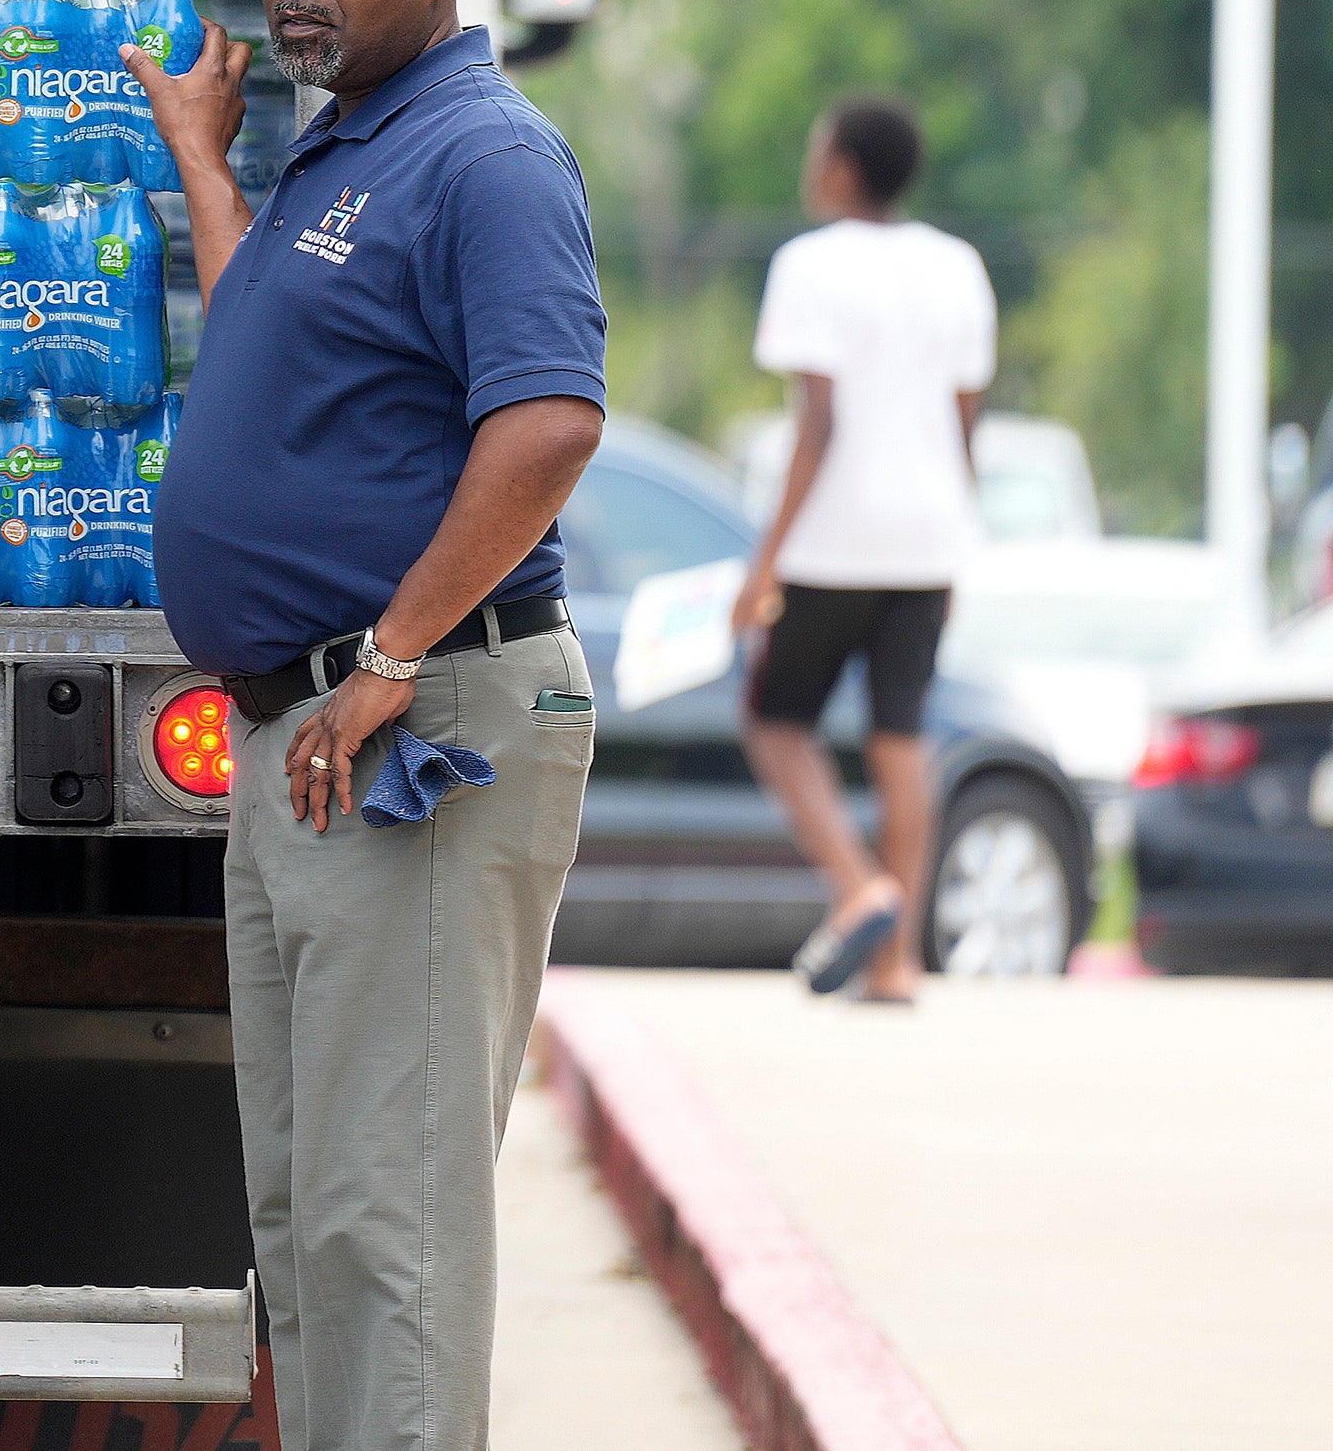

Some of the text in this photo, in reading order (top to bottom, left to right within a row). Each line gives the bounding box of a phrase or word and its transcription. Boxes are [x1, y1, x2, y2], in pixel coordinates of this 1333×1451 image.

[142, 34, 164, 51] 24
[24, 102, 153, 118] PURIFIED DRINKING WATE
[300, 228, 355, 255] HOUSTON
[100, 244, 124, 261] 24
[317, 247, 348, 265] WORKS
[48, 313, 92, 325] DRINKING
[93, 316, 120, 329] WATER
[141, 448, 164, 466] 24
[17, 483, 151, 541] niagara
[31, 521, 153, 537] PURIFIED DRINKING WAT
